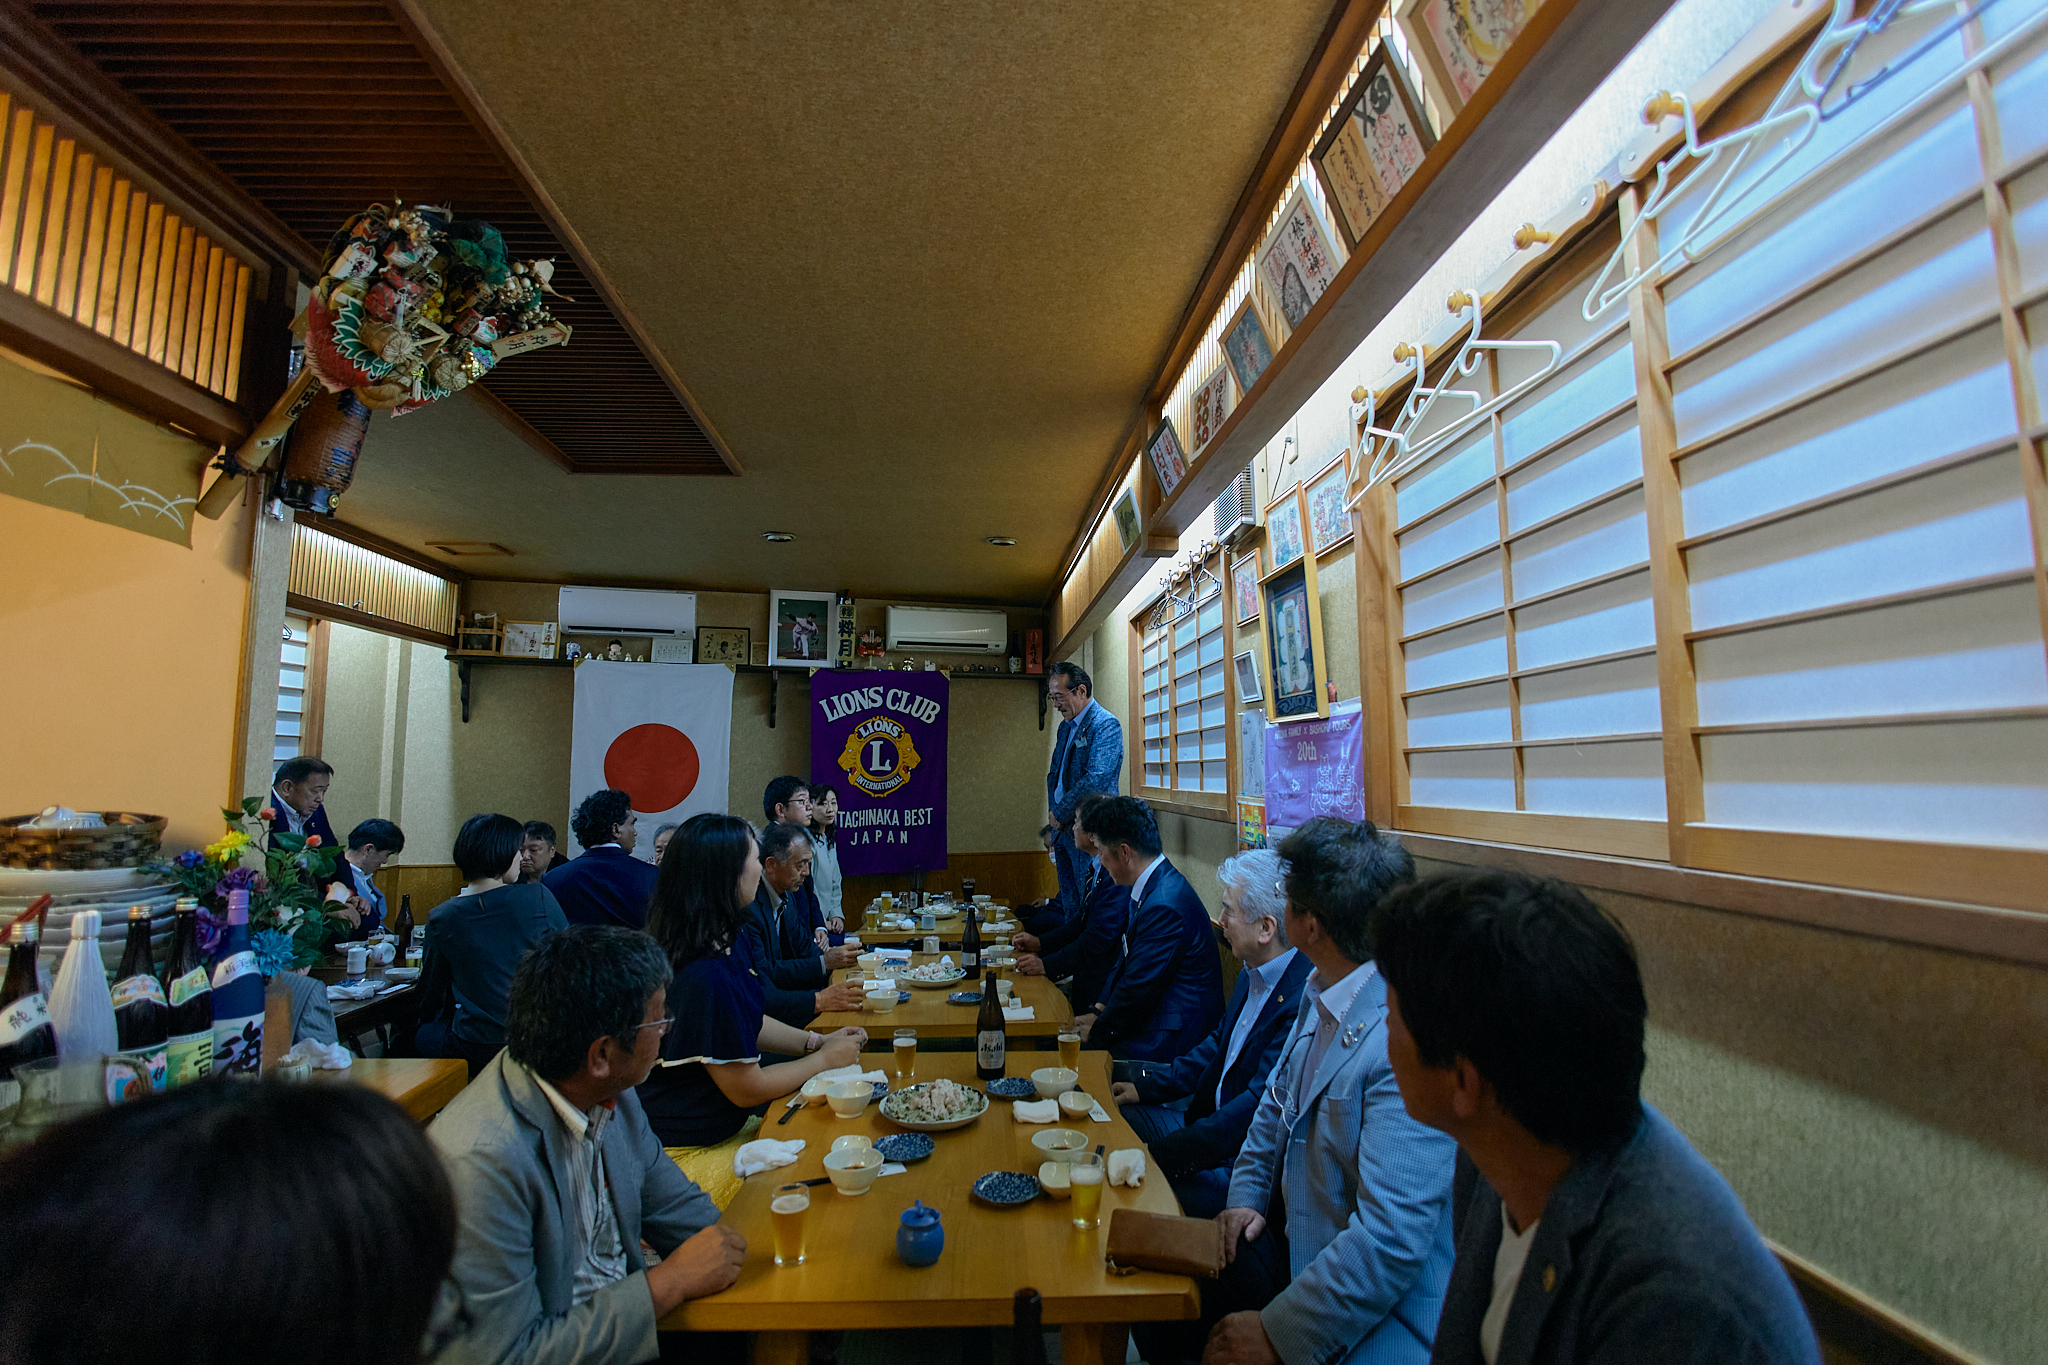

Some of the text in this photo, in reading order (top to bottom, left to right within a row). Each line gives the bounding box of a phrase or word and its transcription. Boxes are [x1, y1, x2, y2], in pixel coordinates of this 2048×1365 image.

[818, 685, 941, 724] LIONS CLUB
[858, 719, 901, 738] LIONS
[869, 740, 892, 772] L
[1297, 741, 1317, 761] 20th
[856, 775, 903, 791] INTERNATIONAL
[838, 807, 934, 828] TACHINAKA BEST
[850, 829, 909, 846] JAPAN
[981, 1042, 1002, 1053] Asahi
